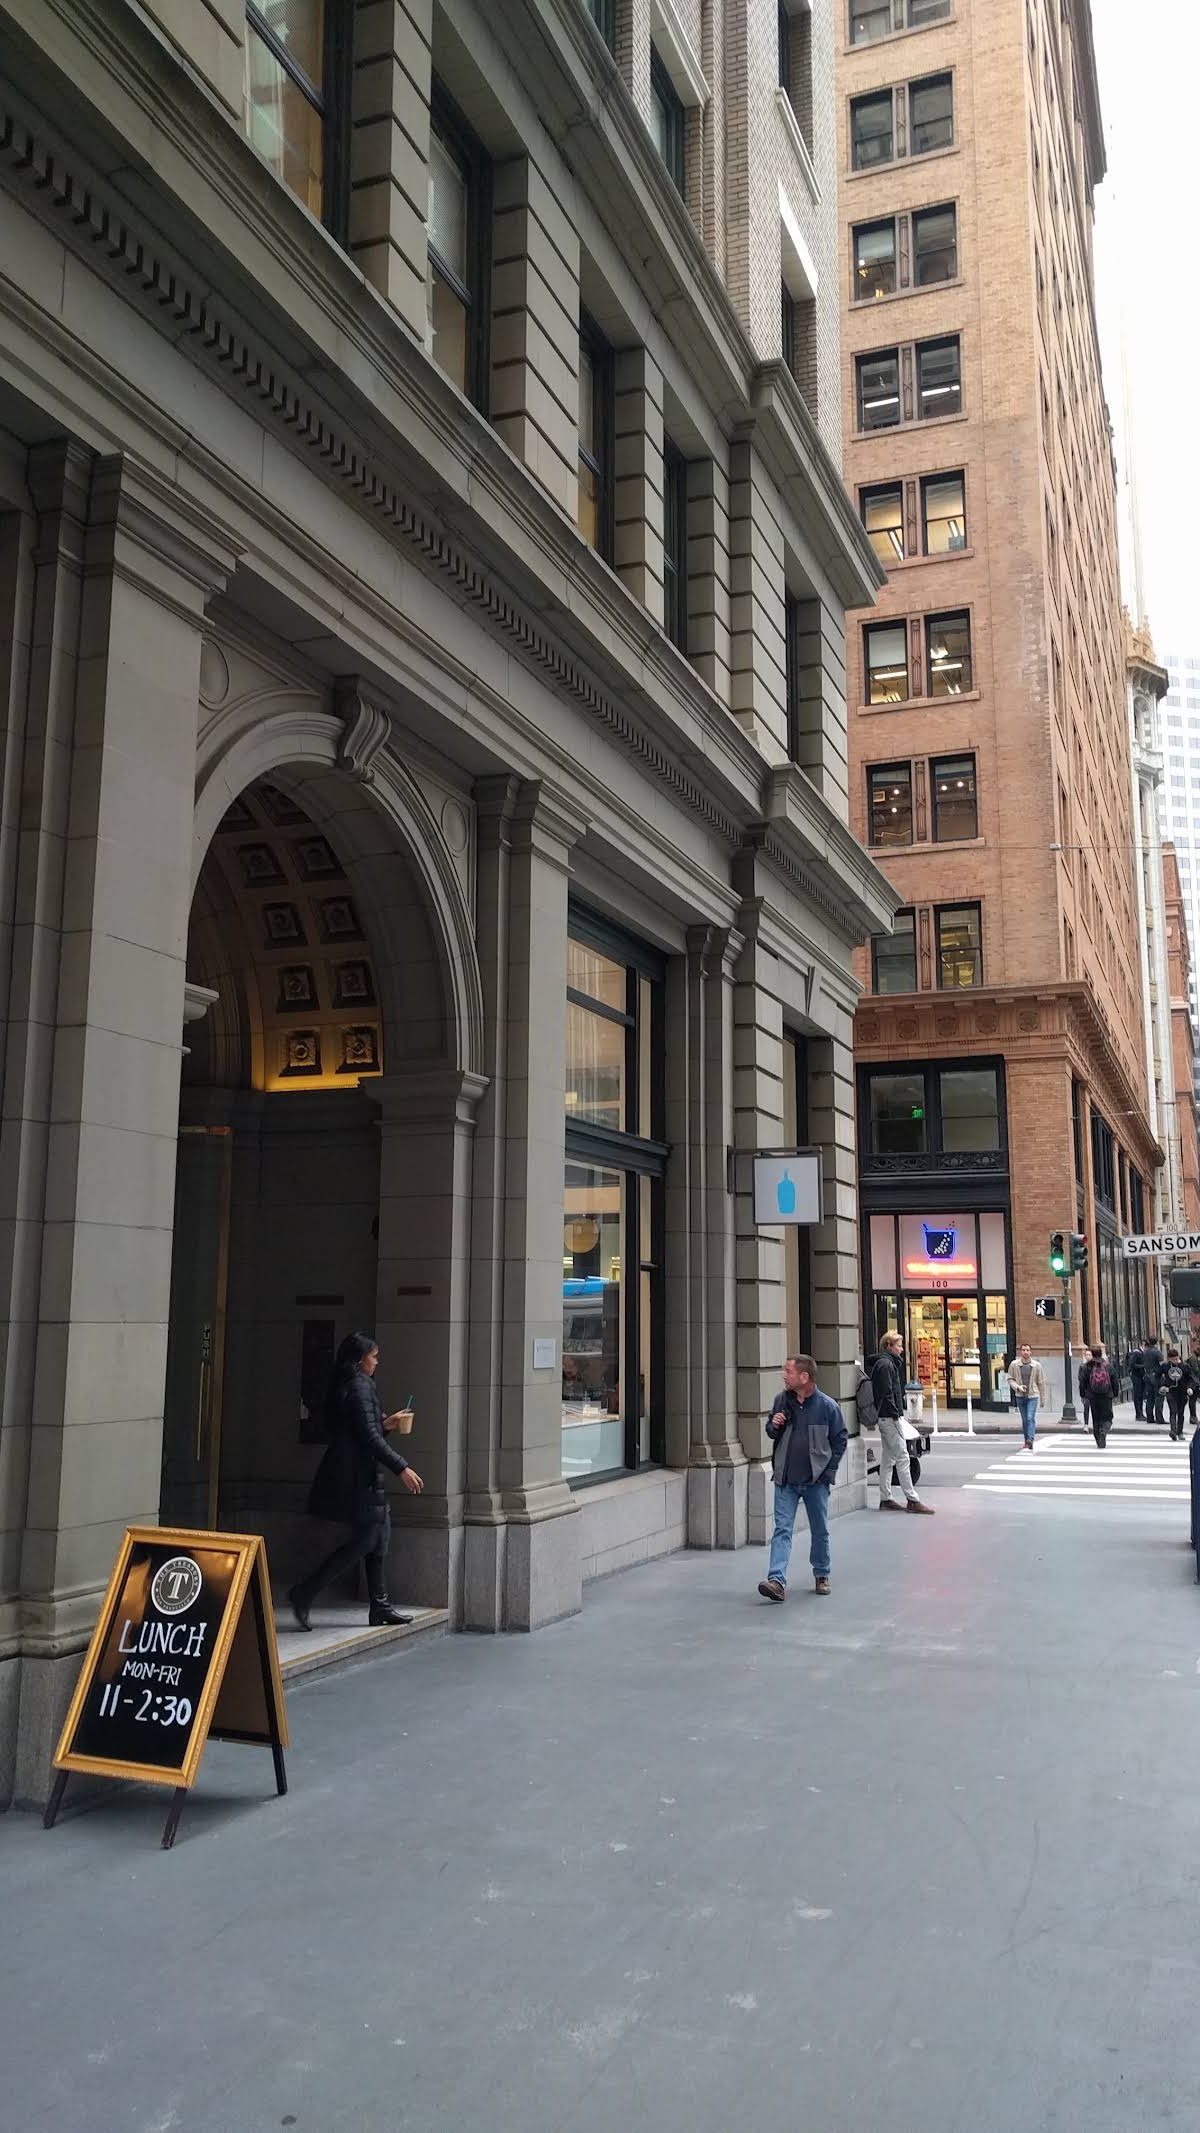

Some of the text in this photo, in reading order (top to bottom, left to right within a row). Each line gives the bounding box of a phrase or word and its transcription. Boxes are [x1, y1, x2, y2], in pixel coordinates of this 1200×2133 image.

[1166, 1223, 1178, 1232] 100
[931, 1280, 948, 1288] 100
[167, 1571, 190, 1600] T
[118, 1619, 208, 1657] LUNCH
[121, 1660, 182, 1686] MON-FRI
